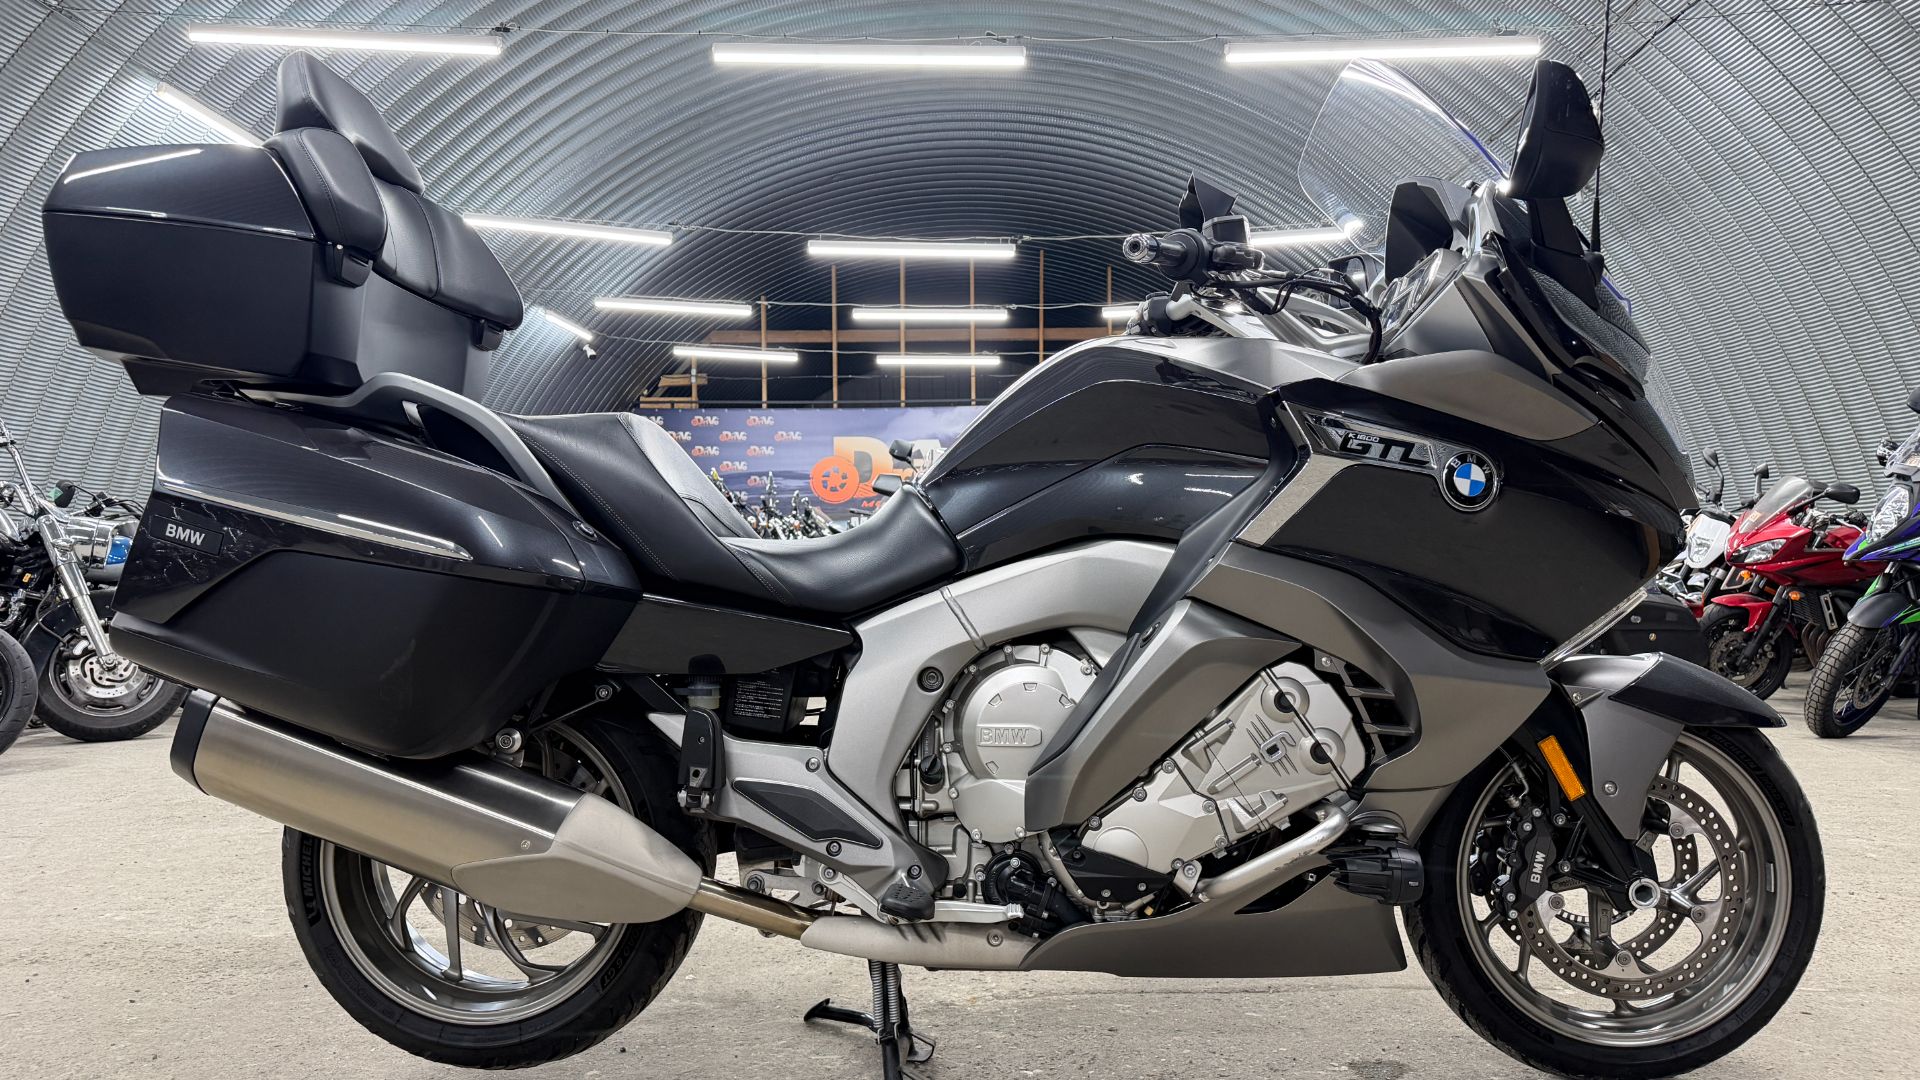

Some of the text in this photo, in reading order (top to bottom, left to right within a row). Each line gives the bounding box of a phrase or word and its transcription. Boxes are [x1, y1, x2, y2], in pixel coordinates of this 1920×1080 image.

[1340, 432, 1430, 465] GTL
[1451, 453, 1492, 475] BMW
[165, 523, 206, 546] BMW
[979, 727, 1029, 745] BMW
[1530, 850, 1547, 884] BMW
